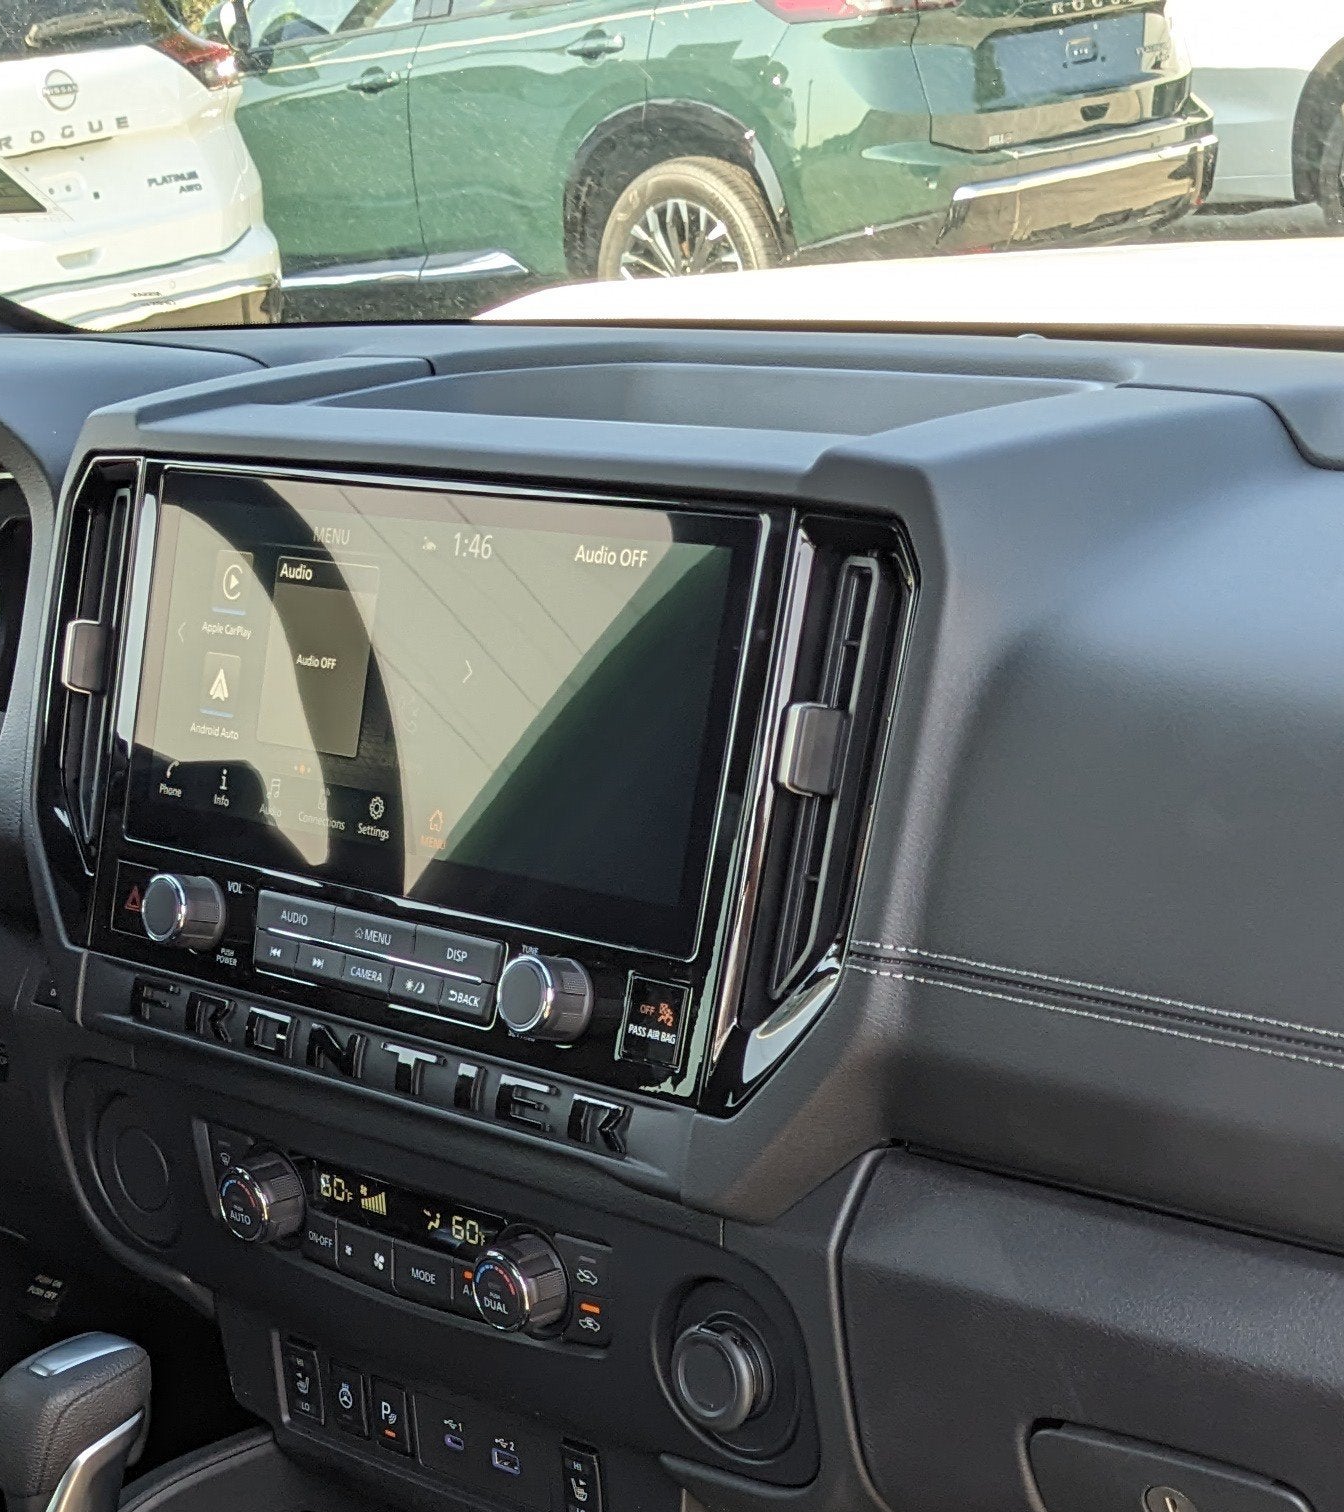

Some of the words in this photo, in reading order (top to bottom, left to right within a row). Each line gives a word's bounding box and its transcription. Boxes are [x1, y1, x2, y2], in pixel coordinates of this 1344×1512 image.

[312, 526, 351, 546] MENU
[454, 532, 493, 559] 1:46
[574, 544, 616, 566] Audio
[619, 548, 648, 567] OFF
[279, 563, 313, 581] Audio
[201, 621, 224, 637] Apple
[225, 624, 254, 640] CarPlay
[296, 654, 319, 668] Audio
[320, 657, 337, 670] OFF
[190, 722, 219, 737] Android
[220, 726, 239, 740] Auto
[159, 783, 182, 798] Phone
[213, 793, 230, 807] Info
[298, 811, 346, 831] Connections
[357, 822, 390, 841] Settings
[227, 881, 243, 894] VOL
[280, 910, 308, 926] AUDIO
[365, 930, 392, 946] MENU
[216, 954, 237, 966] POWER
[447, 947, 468, 963] DISP
[350, 966, 383, 983] CAMERA
[457, 989, 481, 1008] BACK
[639, 1004, 655, 1016] OFF
[628, 1024, 647, 1038] PASS
[660, 1031, 677, 1045] BAG
[130, 974, 633, 1156] FRONTIER
[230, 1210, 251, 1226] AUTO
[411, 1267, 437, 1285] MODE
[483, 1298, 508, 1315] DUAL
